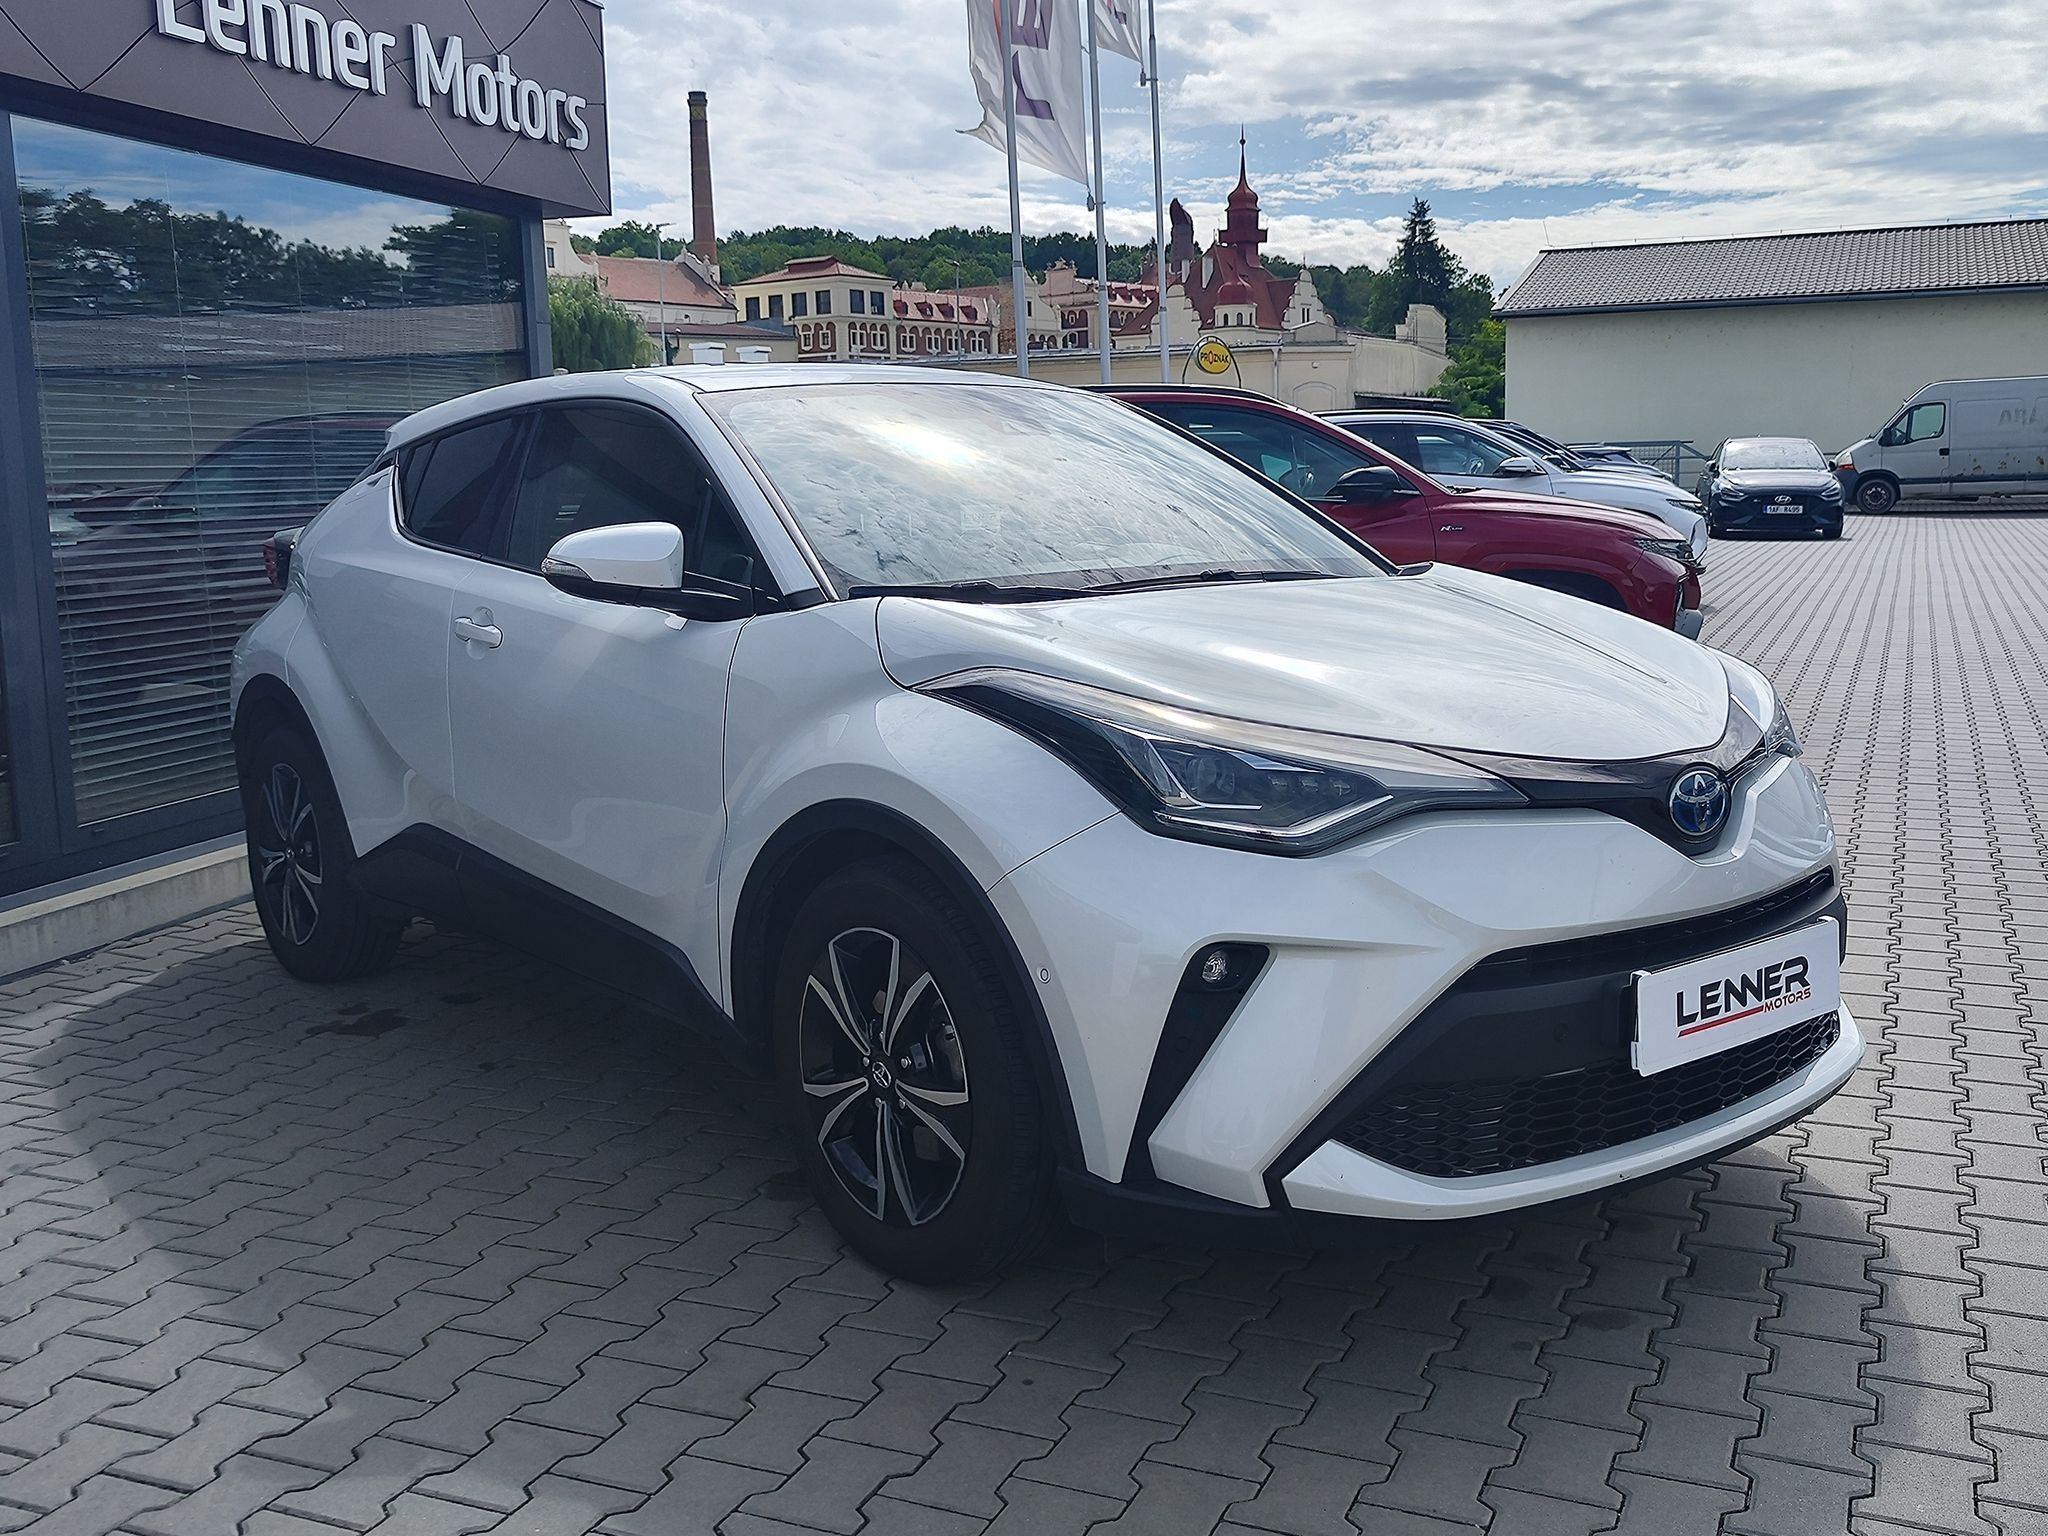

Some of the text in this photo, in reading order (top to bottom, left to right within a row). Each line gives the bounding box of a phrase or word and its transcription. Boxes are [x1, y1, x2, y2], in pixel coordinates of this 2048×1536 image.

[411, 22, 589, 150] Motors
[1677, 956, 1811, 1027] LENNER
[1764, 988, 1811, 1013] MOTORS
